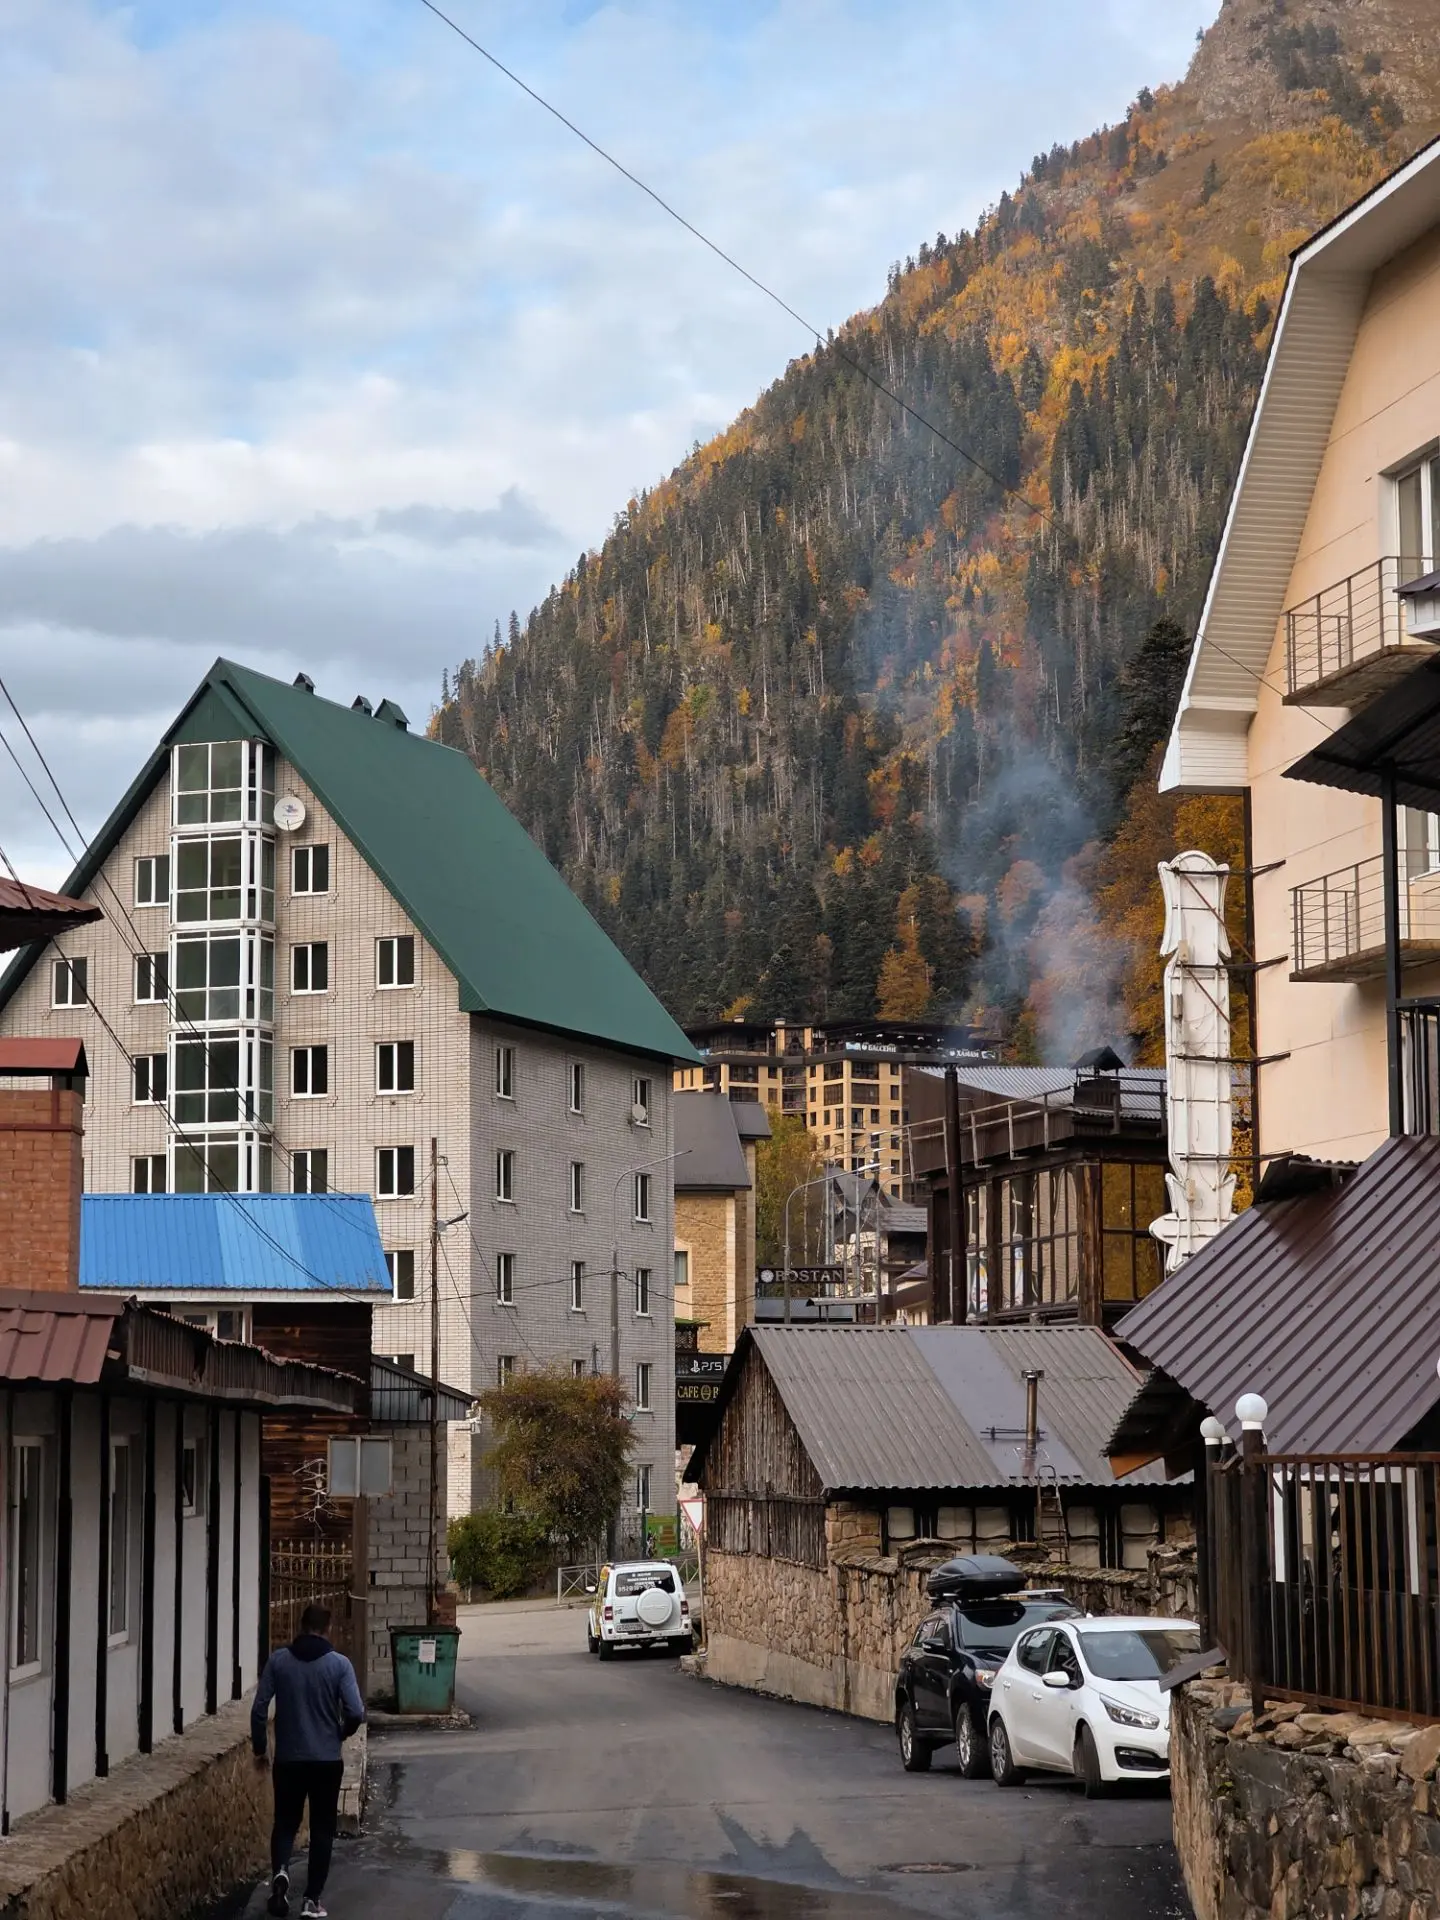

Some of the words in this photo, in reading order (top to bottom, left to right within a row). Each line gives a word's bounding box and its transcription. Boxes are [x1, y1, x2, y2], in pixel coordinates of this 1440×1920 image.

[775, 1269, 843, 1282] BOSTAN
[701, 1361, 722, 1371] PS5
[677, 1385, 699, 1399] CAFE
